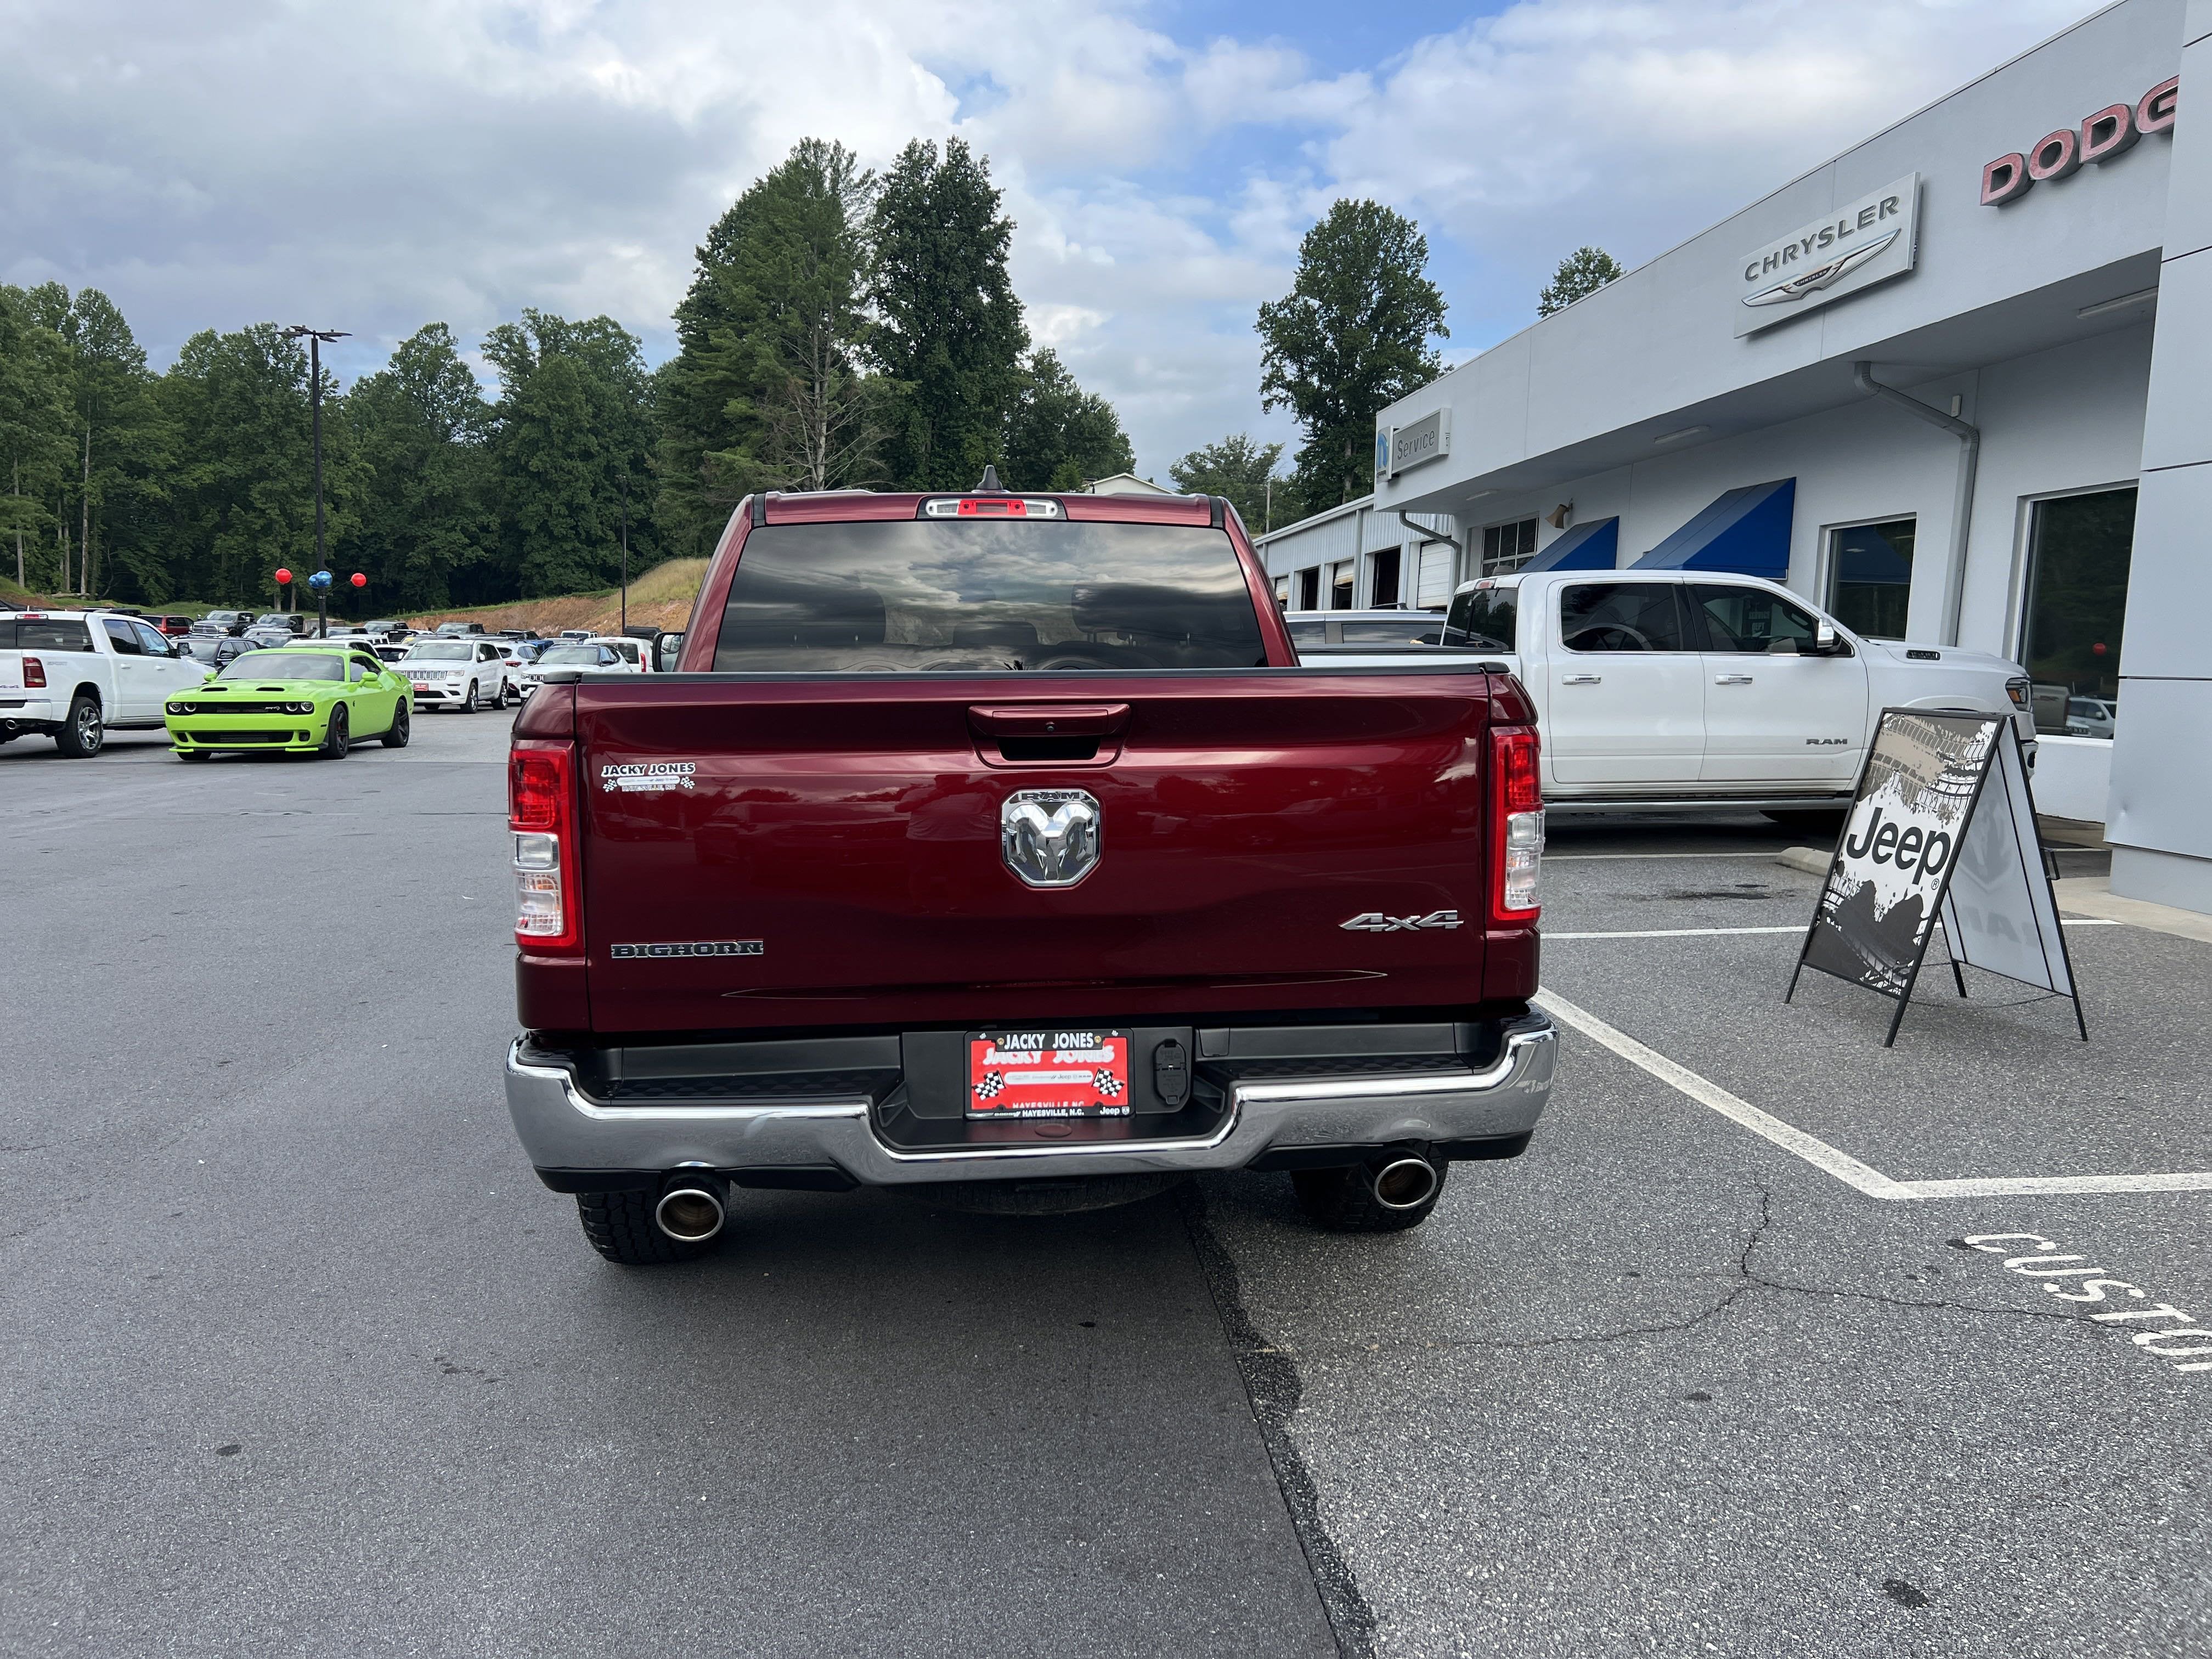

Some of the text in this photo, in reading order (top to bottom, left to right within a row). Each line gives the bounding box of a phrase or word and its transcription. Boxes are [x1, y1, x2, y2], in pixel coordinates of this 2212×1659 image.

[1745, 195, 1899, 282] CHRYSLER
[1796, 269, 1828, 286] CHRYSLER
[1397, 430, 1435, 460] Service
[602, 763, 695, 776] JACKY JONES
[1021, 792, 1080, 801] RAM
[1846, 806, 1951, 885] Jeep
[1338, 909, 1465, 932] 4x4
[610, 940, 764, 959] BIGHORN
[1004, 1032, 1094, 1050] JACKY JONES
[983, 1045, 1115, 1065] JACKY JONES
[1099, 1106, 1120, 1116] Jeep
